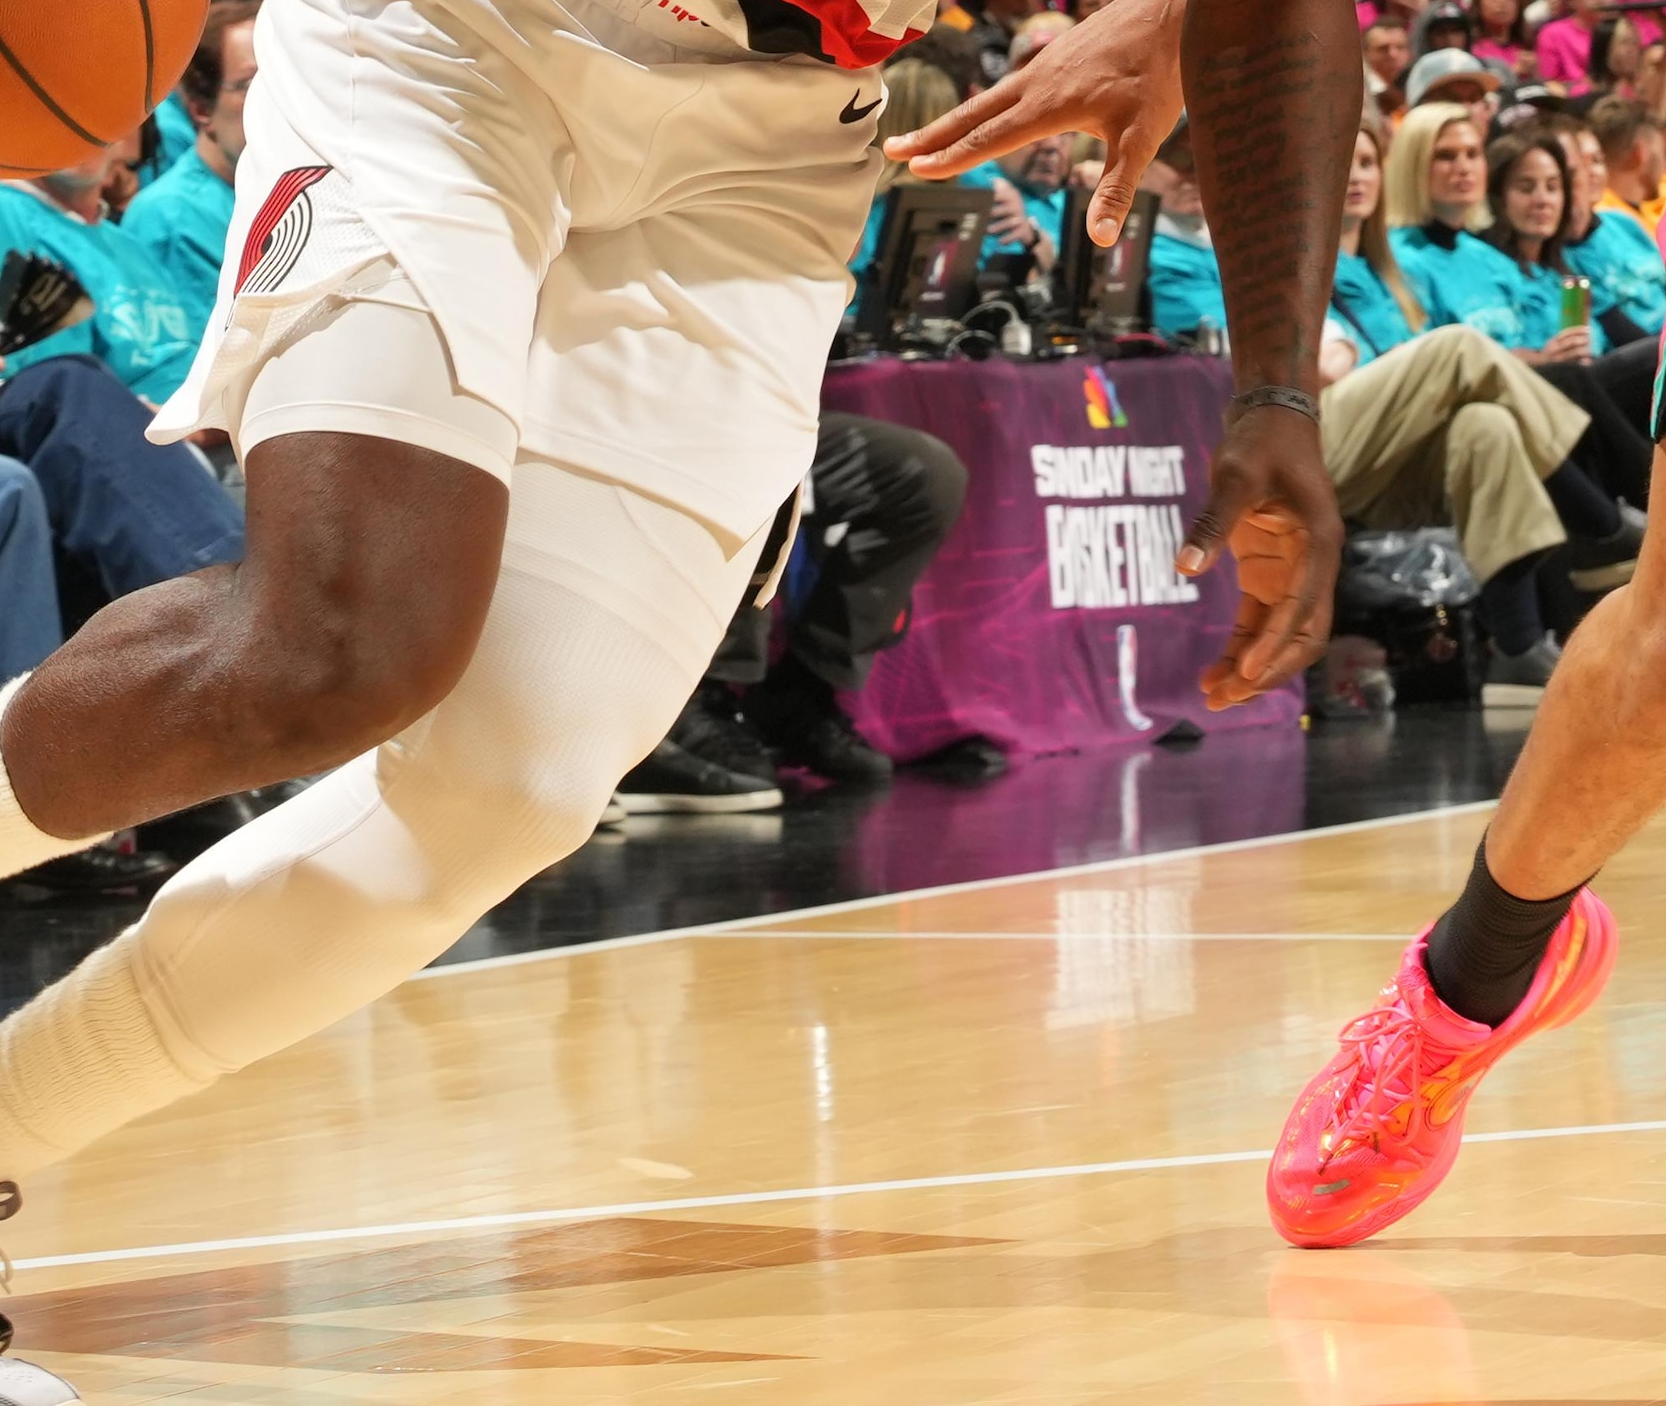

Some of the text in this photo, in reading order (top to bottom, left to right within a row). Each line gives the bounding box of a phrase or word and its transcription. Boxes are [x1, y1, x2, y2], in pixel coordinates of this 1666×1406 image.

[1031, 444, 1186, 498] SNDAY NGHT
[1045, 504, 1200, 609] BSKETBALL
